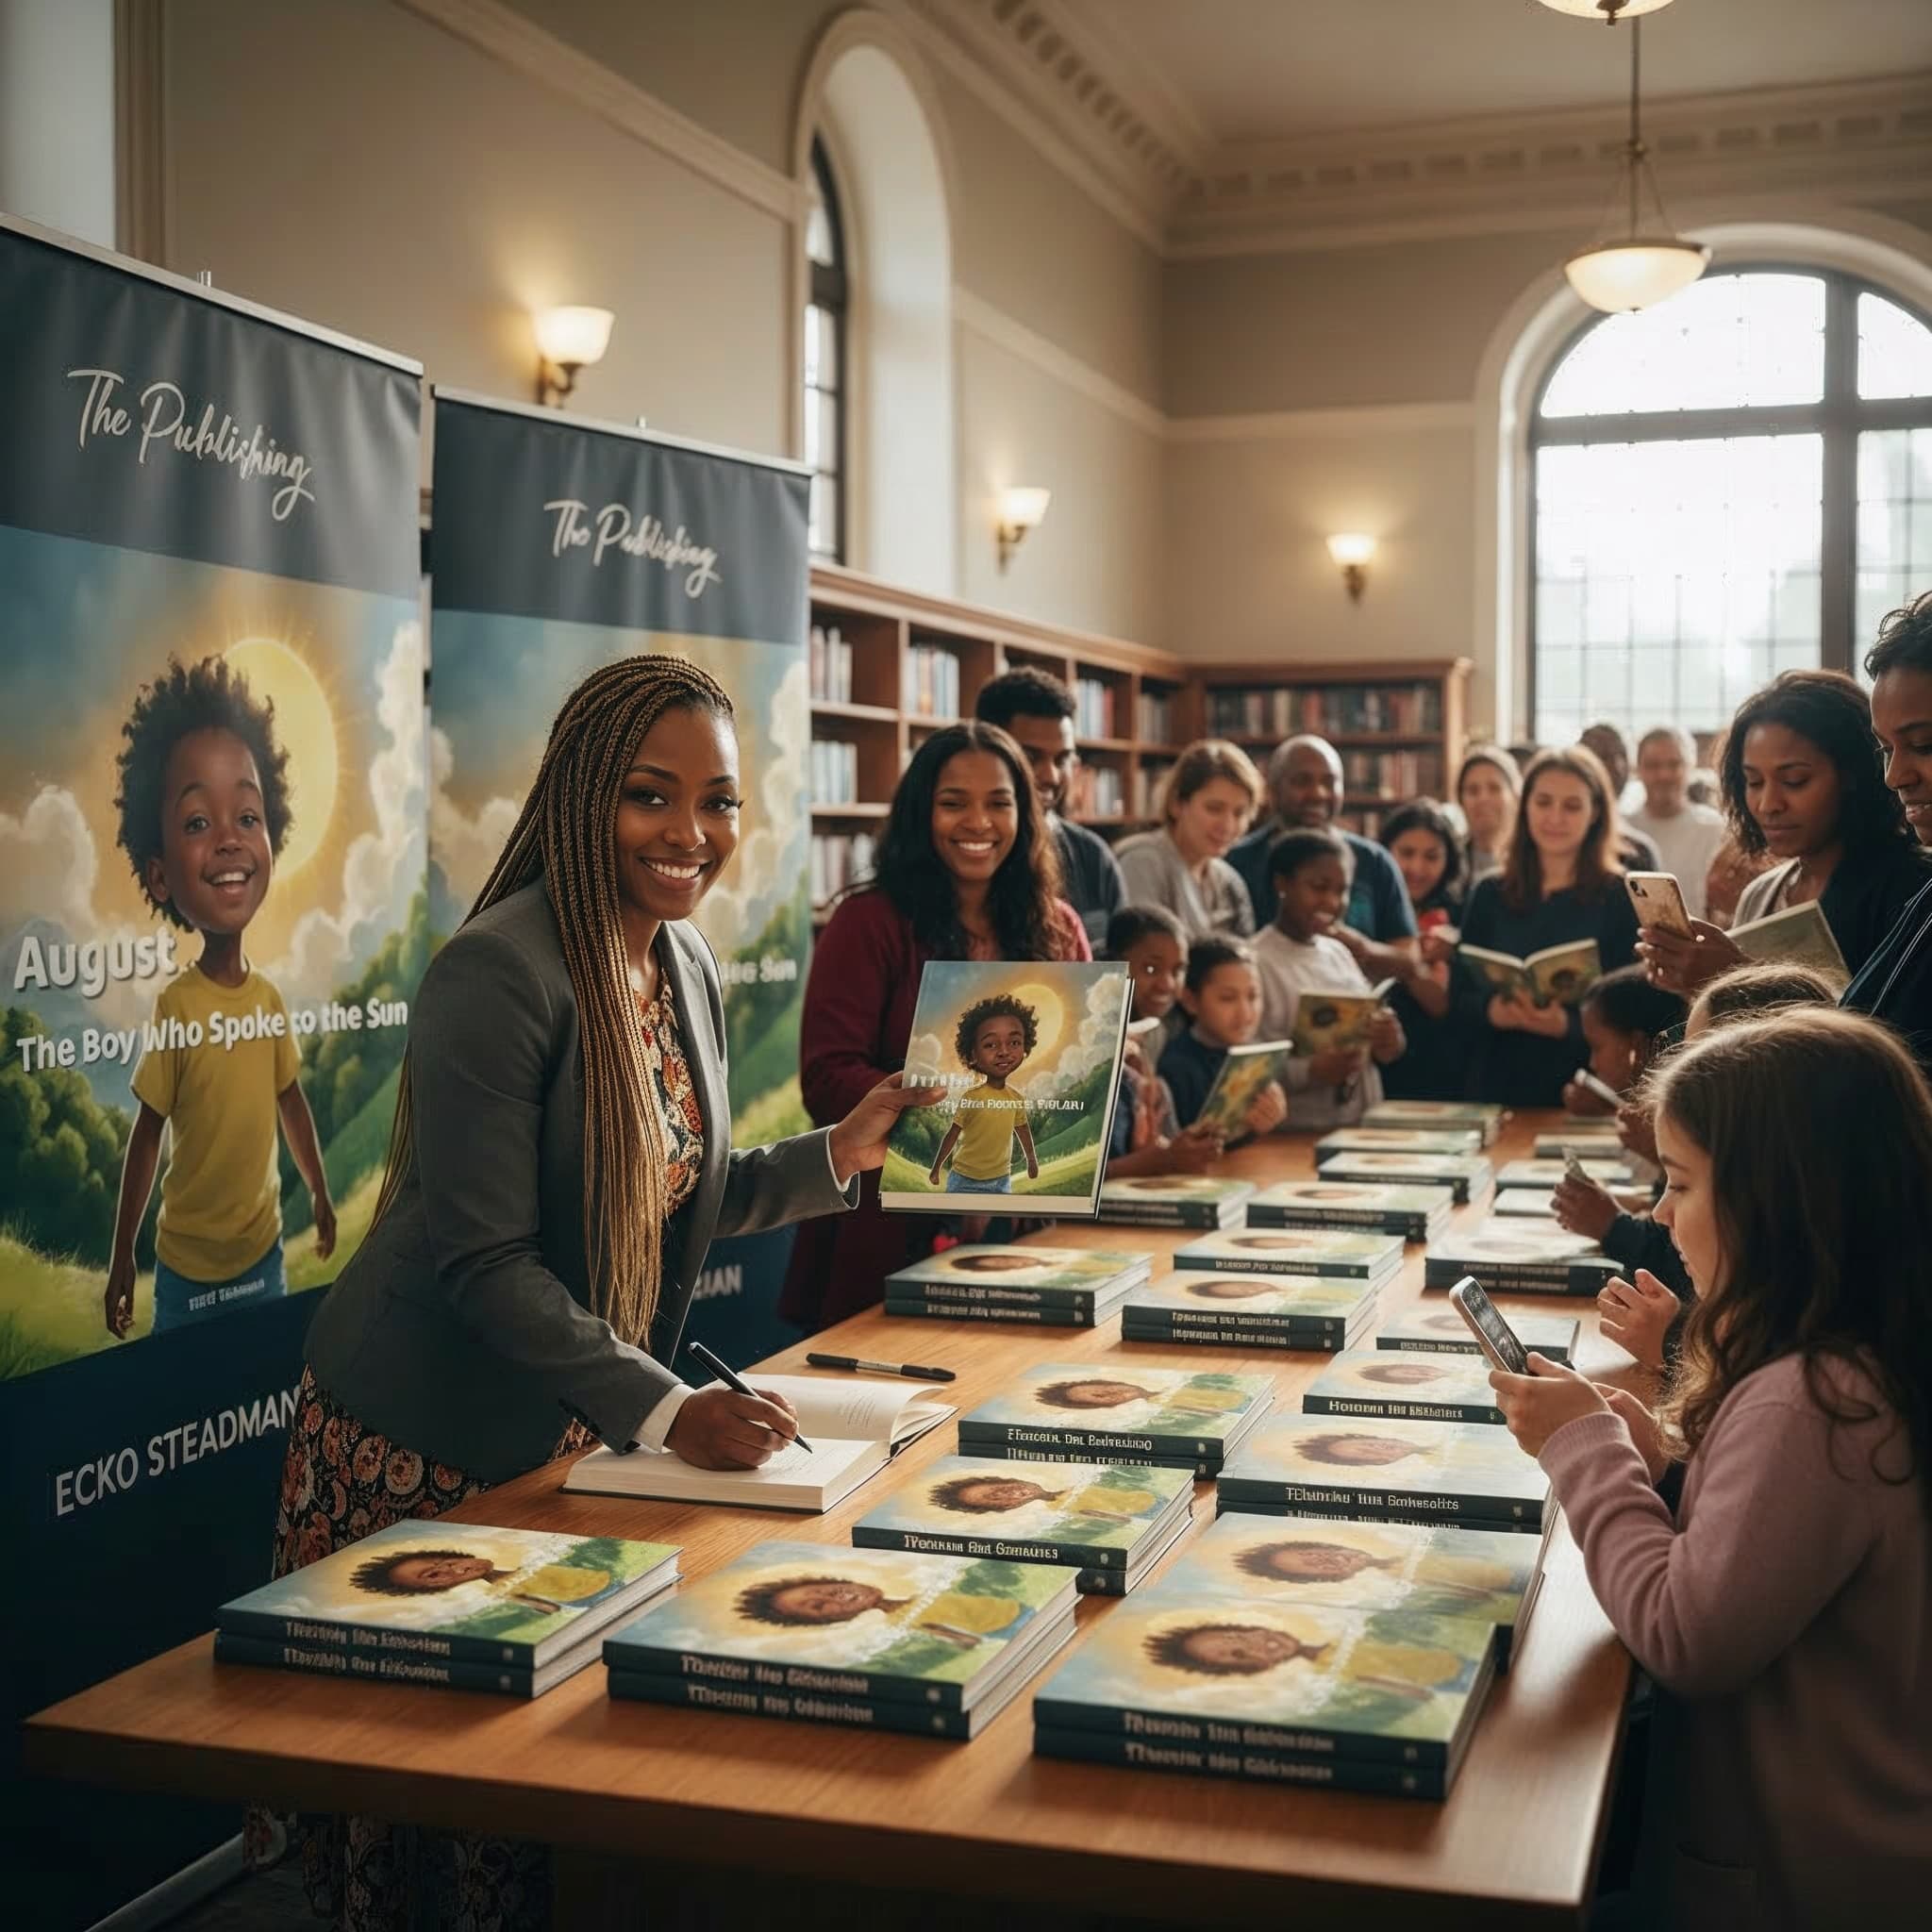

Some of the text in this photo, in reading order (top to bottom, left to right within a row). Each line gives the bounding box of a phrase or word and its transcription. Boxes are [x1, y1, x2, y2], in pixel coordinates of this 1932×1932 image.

[67, 369, 316, 522] The Publishing
[13, 927, 178, 998] August
[16, 1036, 76, 1073] The
[82, 1027, 137, 1066] Boy
[142, 1015, 204, 1054] Who
[208, 1005, 287, 1052] Spoke
[322, 1000, 363, 1031] the
[366, 996, 408, 1028] Sun
[56, 1384, 301, 1517] ECKO STEADMAN
